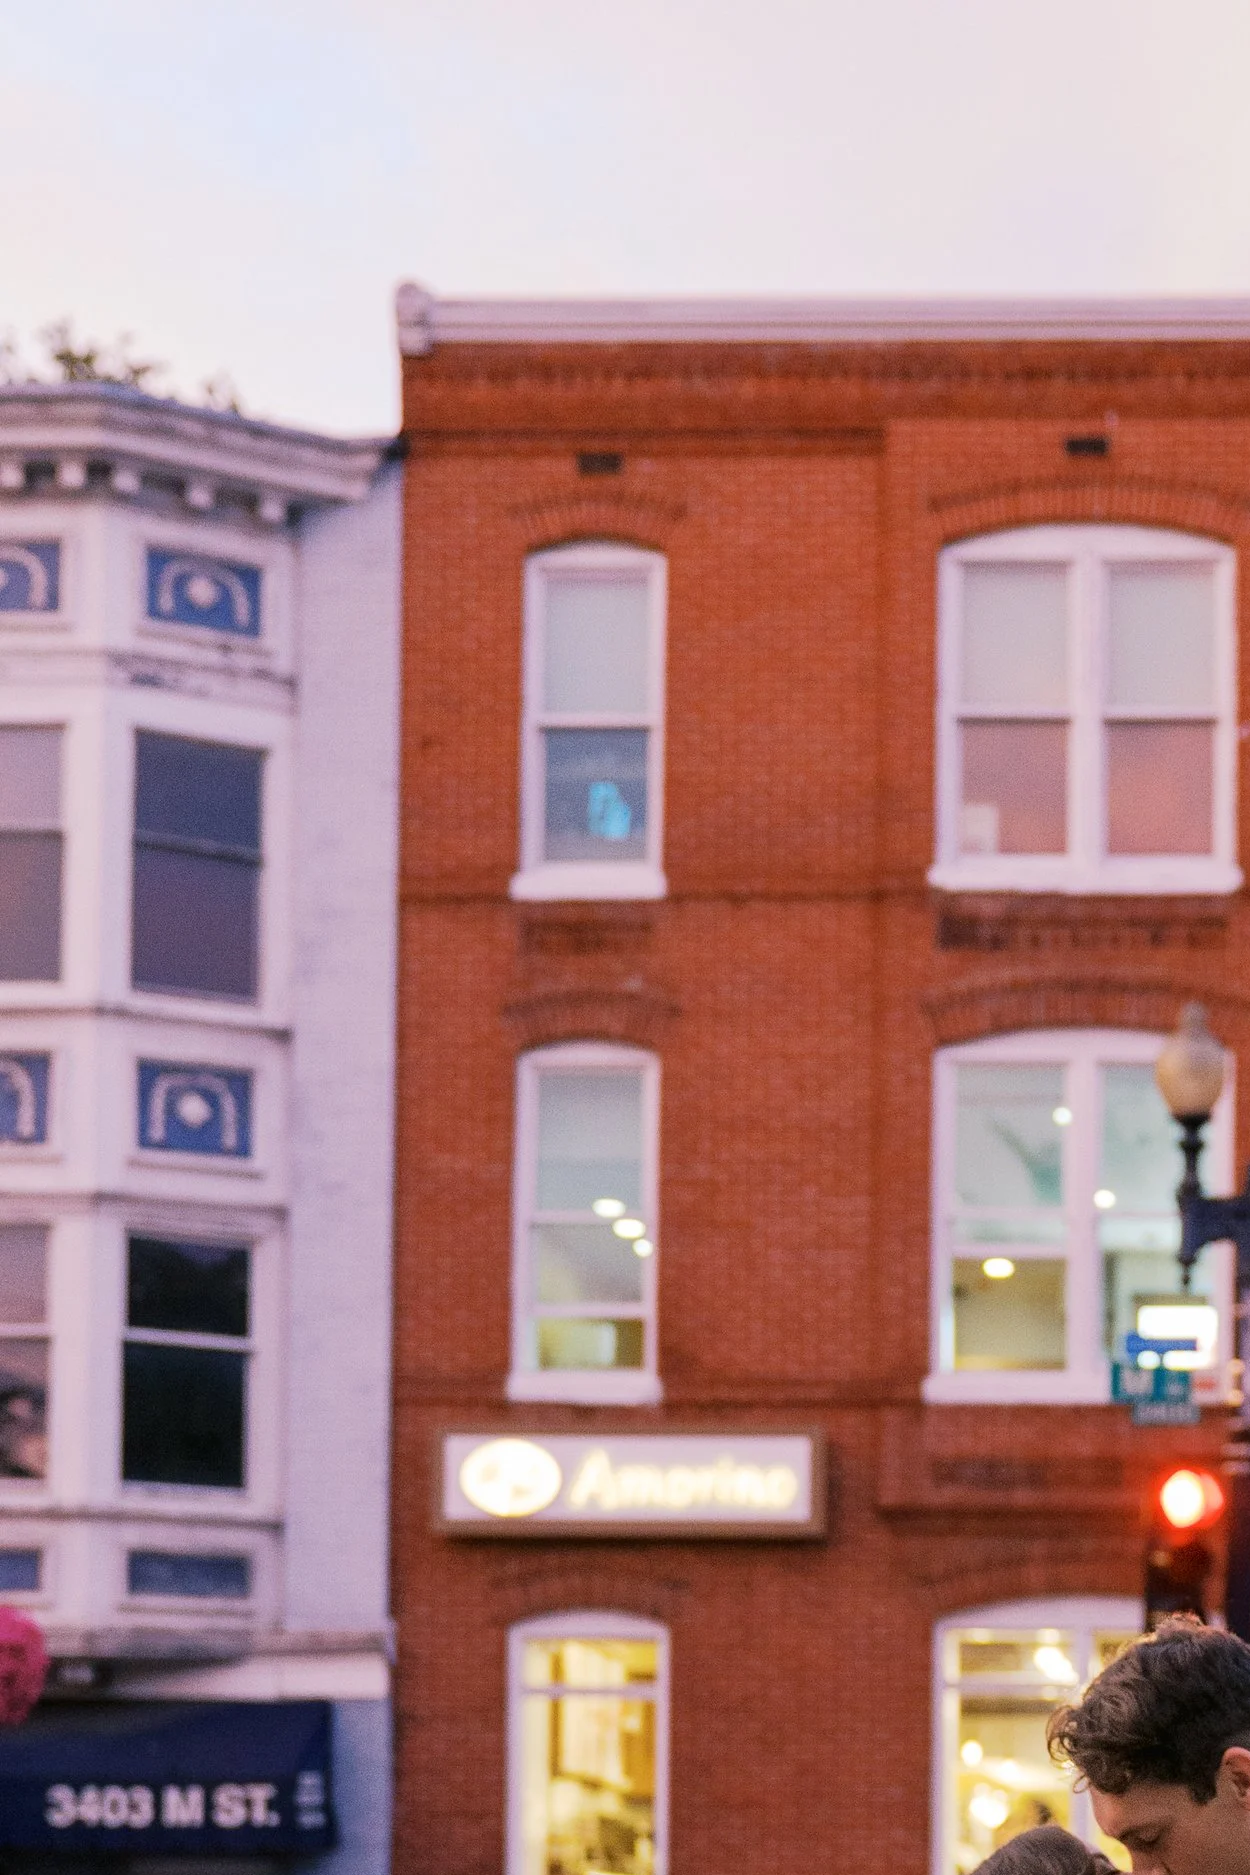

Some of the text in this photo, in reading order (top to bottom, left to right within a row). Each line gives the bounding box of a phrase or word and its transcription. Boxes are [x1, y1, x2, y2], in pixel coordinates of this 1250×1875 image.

[46, 1784, 154, 1829] 3403
[161, 1784, 205, 1829] M
[212, 1782, 281, 1829] ST.
